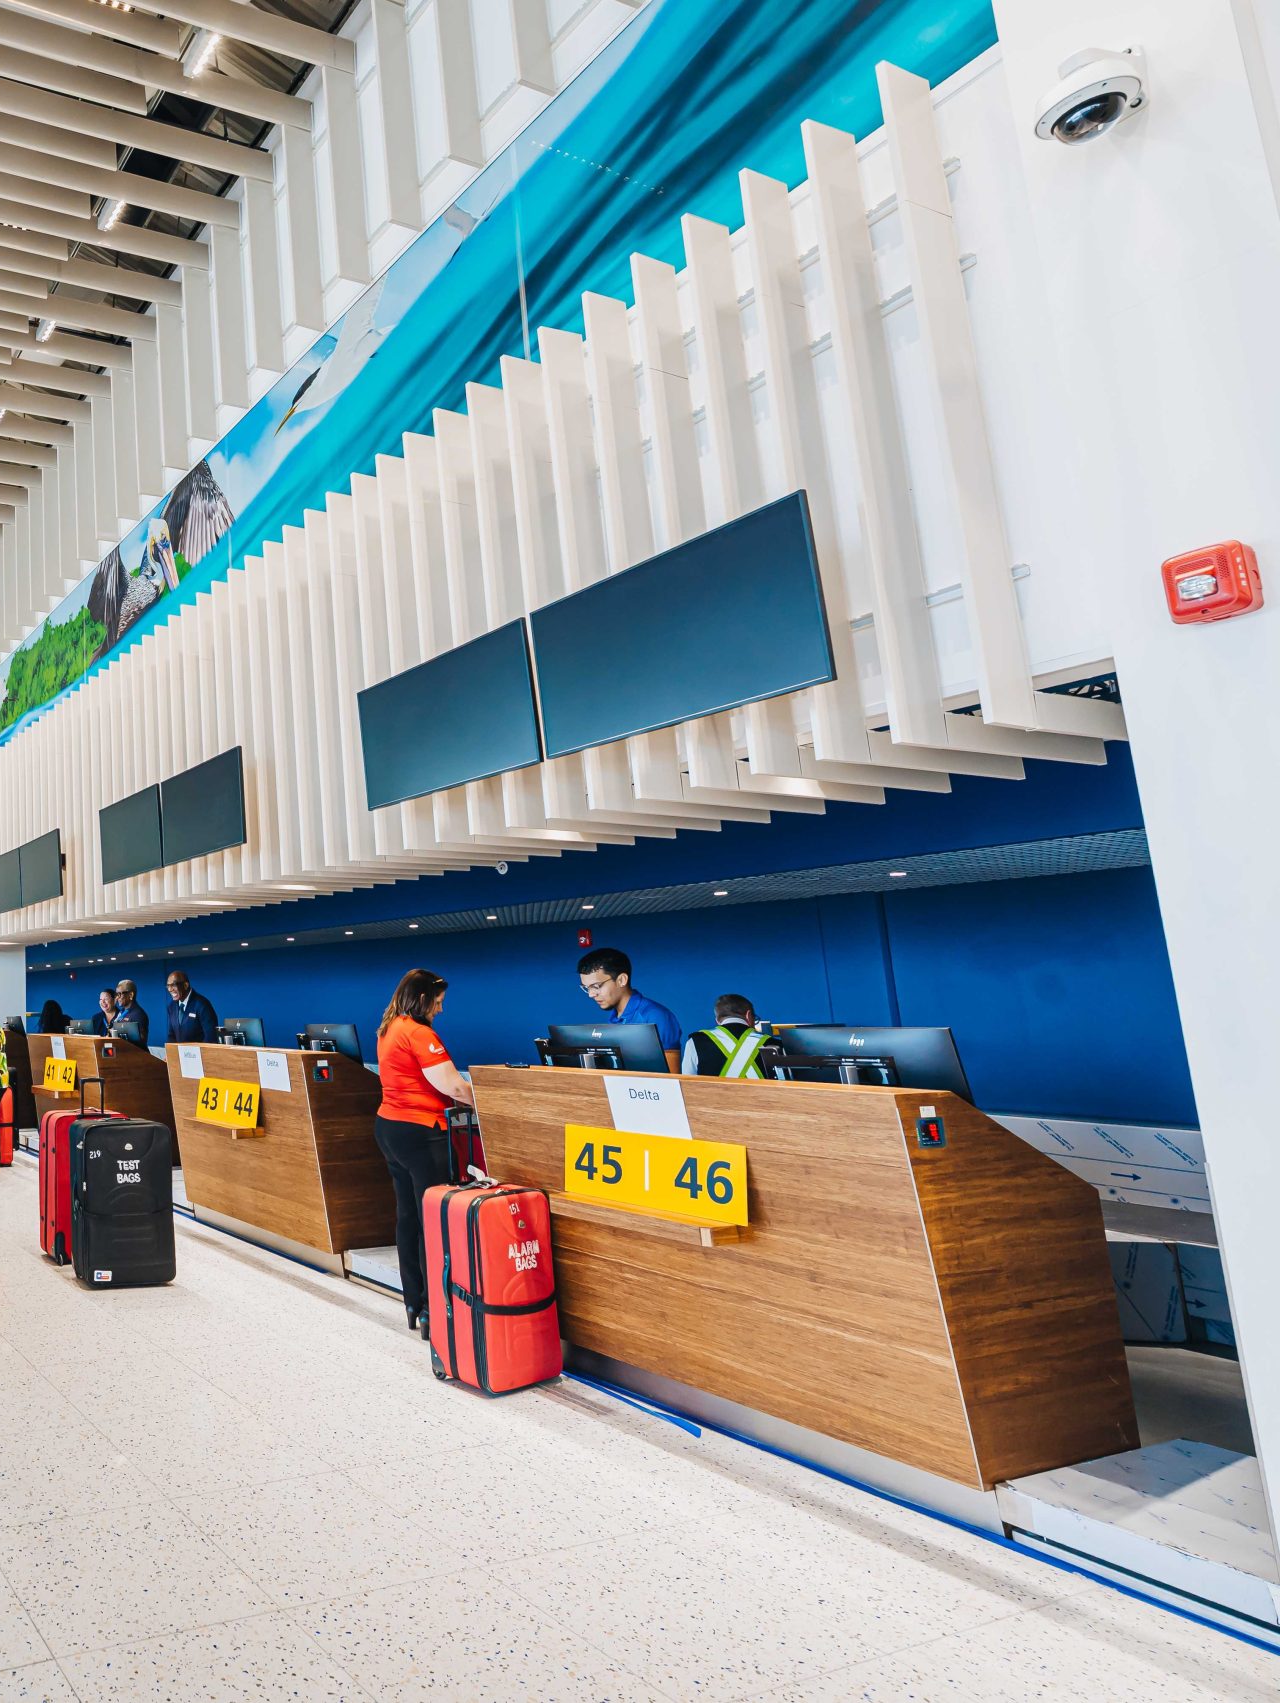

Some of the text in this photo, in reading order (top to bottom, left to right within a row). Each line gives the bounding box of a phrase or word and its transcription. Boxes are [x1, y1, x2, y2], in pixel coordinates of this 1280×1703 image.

[266, 1058, 279, 1068] Delta
[46, 1065, 73, 1083] 41 42
[201, 1087, 253, 1117] 43 44
[629, 1088, 660, 1101] Delta
[89, 1150, 101, 1159] 219
[117, 1160, 140, 1171] TEST
[574, 1142, 733, 1204] 45 46
[116, 1172, 141, 1184] BAGS
[508, 1240, 540, 1259] ALARM
[515, 1255, 537, 1272] BAGS
